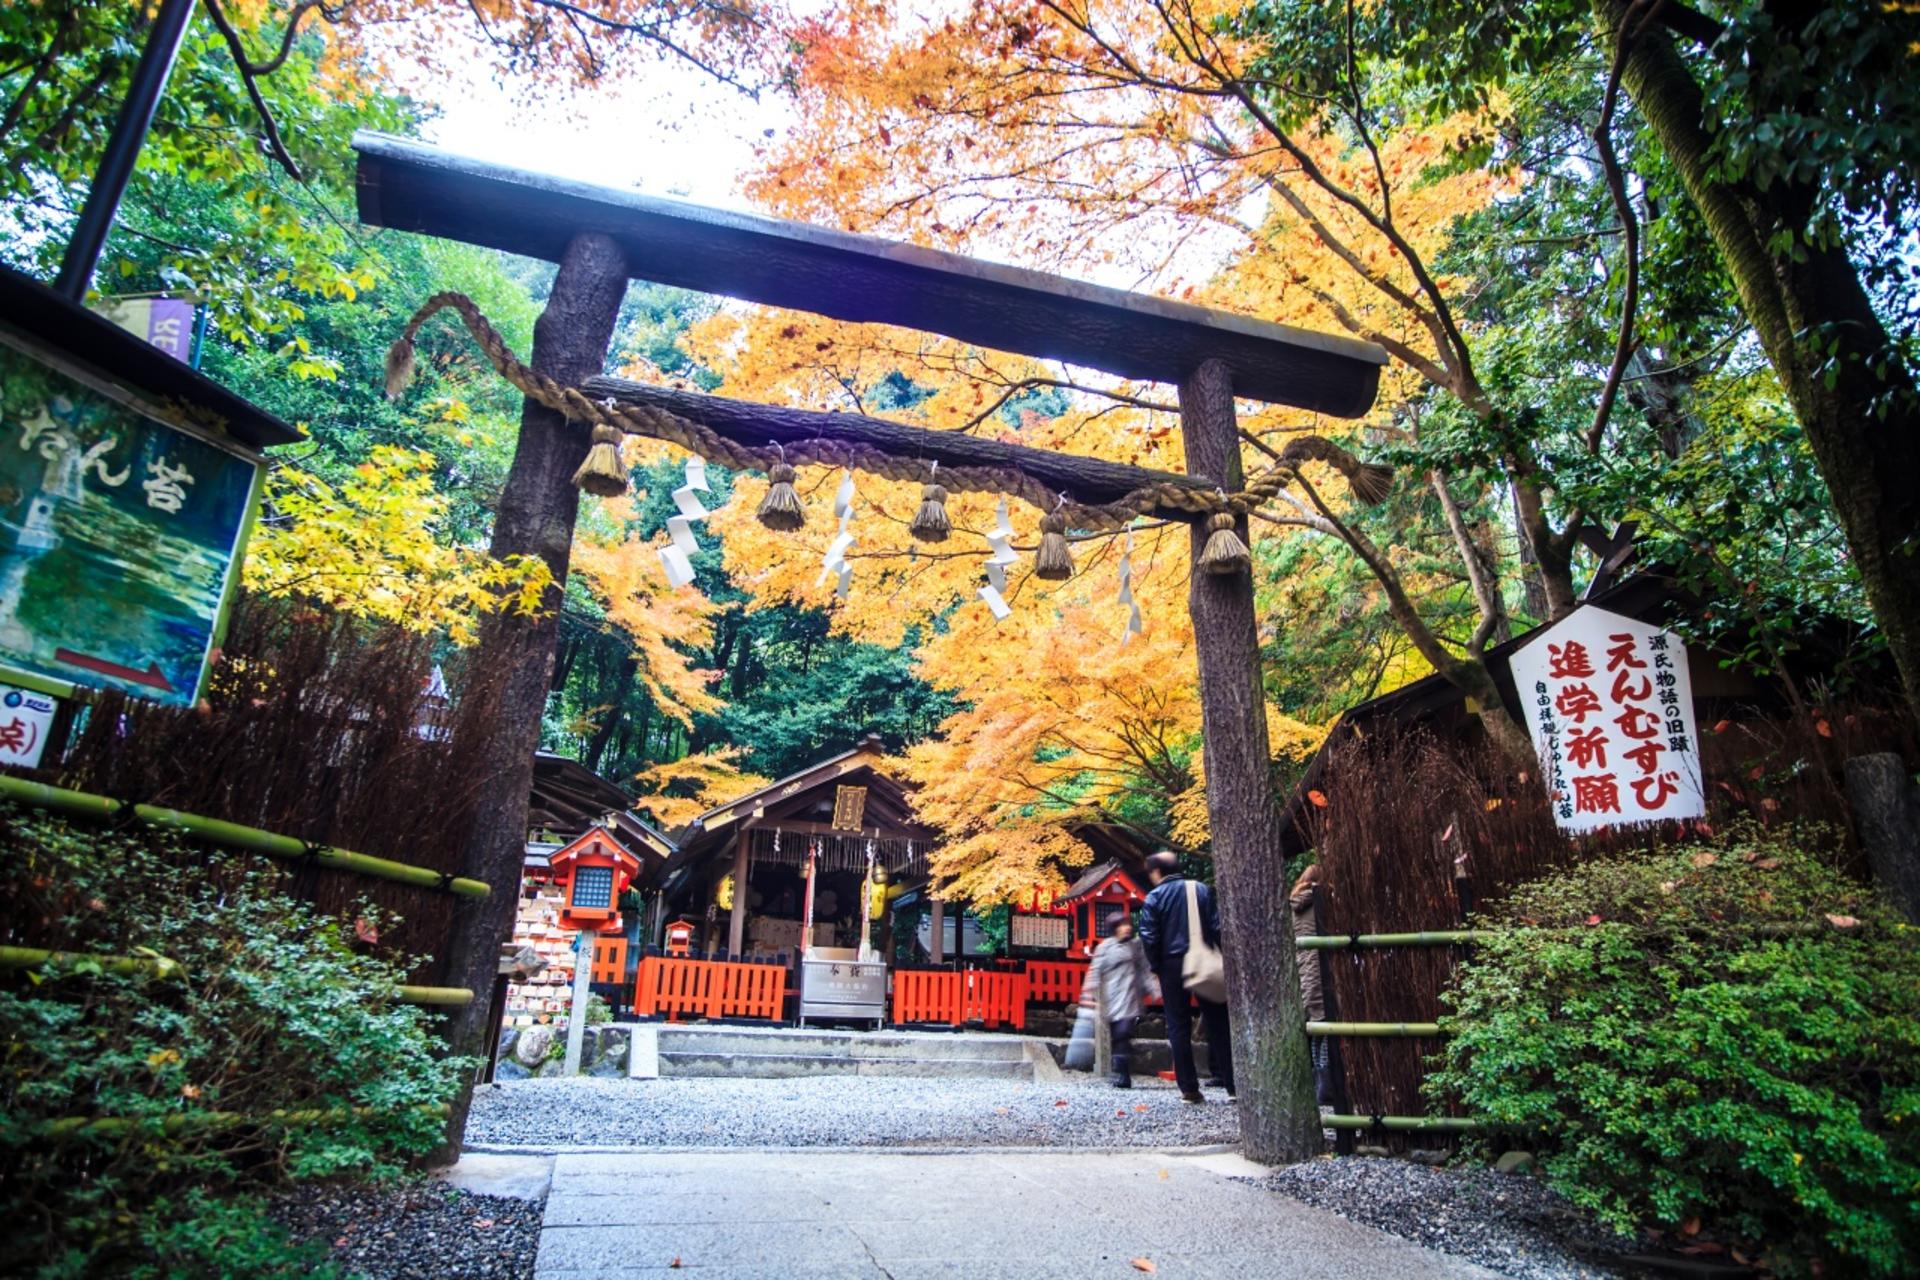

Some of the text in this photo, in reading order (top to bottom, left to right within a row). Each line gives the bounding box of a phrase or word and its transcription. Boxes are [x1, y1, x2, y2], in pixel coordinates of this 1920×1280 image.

[0, 385, 195, 515] たん苔
[1548, 640, 1622, 814] 進学祈願
[1607, 633, 1680, 811] えんむすび
[1648, 635, 1690, 753] 源氏物語の旧蹟
